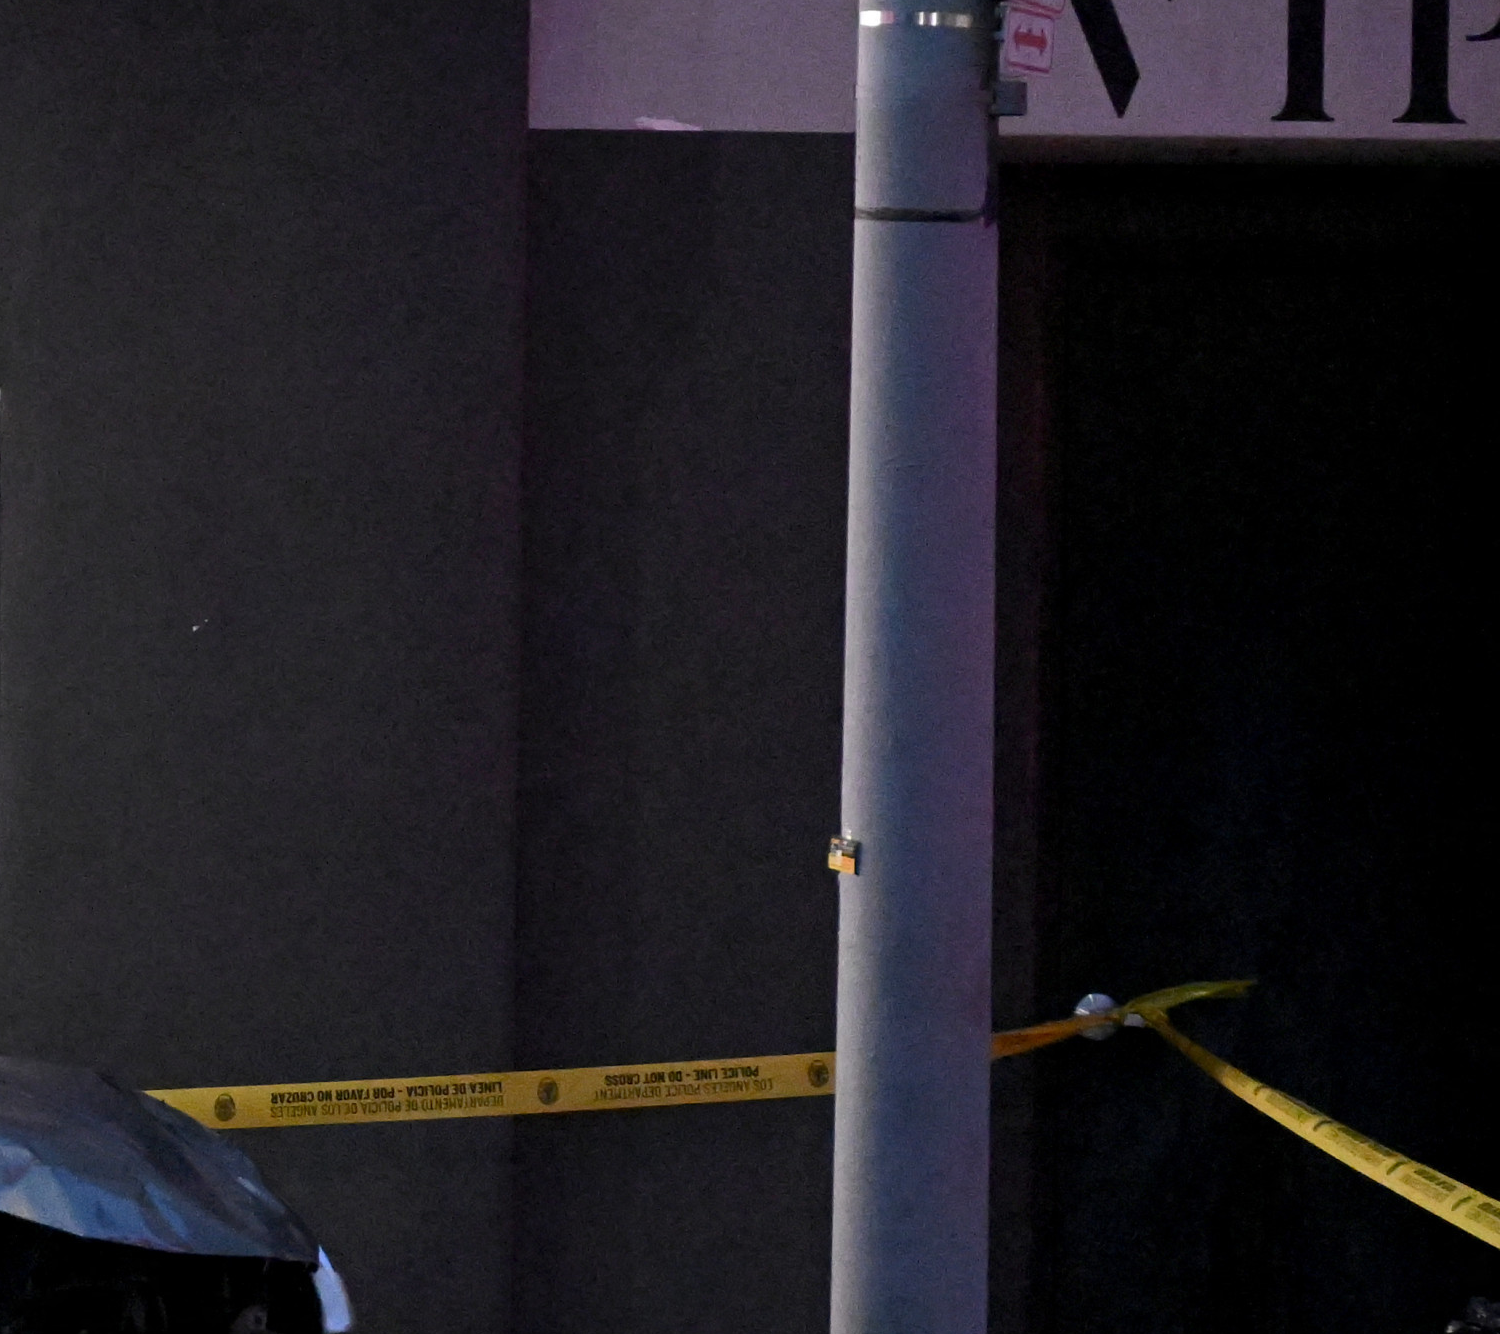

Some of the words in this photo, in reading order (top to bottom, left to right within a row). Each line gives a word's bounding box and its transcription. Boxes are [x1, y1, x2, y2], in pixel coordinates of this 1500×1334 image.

[643, 1072, 665, 1084] NOT
[668, 1070, 682, 1083] DO
[693, 1068, 718, 1081] LINE
[720, 1065, 759, 1080] POLICE
[604, 1073, 640, 1087] CROSS
[374, 1087, 394, 1100] POR
[407, 1085, 449, 1098] POLICIA
[452, 1083, 466, 1096] DE
[470, 1081, 502, 1095] LINEA
[594, 1086, 661, 1101] DEPARTMENT
[664, 1084, 700, 1096] POLICE
[270, 1091, 313, 1104] CRUZAR
[317, 1090, 333, 1102] NO
[336, 1089, 370, 1101] FAVOR
[270, 1104, 317, 1118] ANGELES
[321, 1103, 340, 1115] LOS
[405, 1099, 418, 1112] DE
